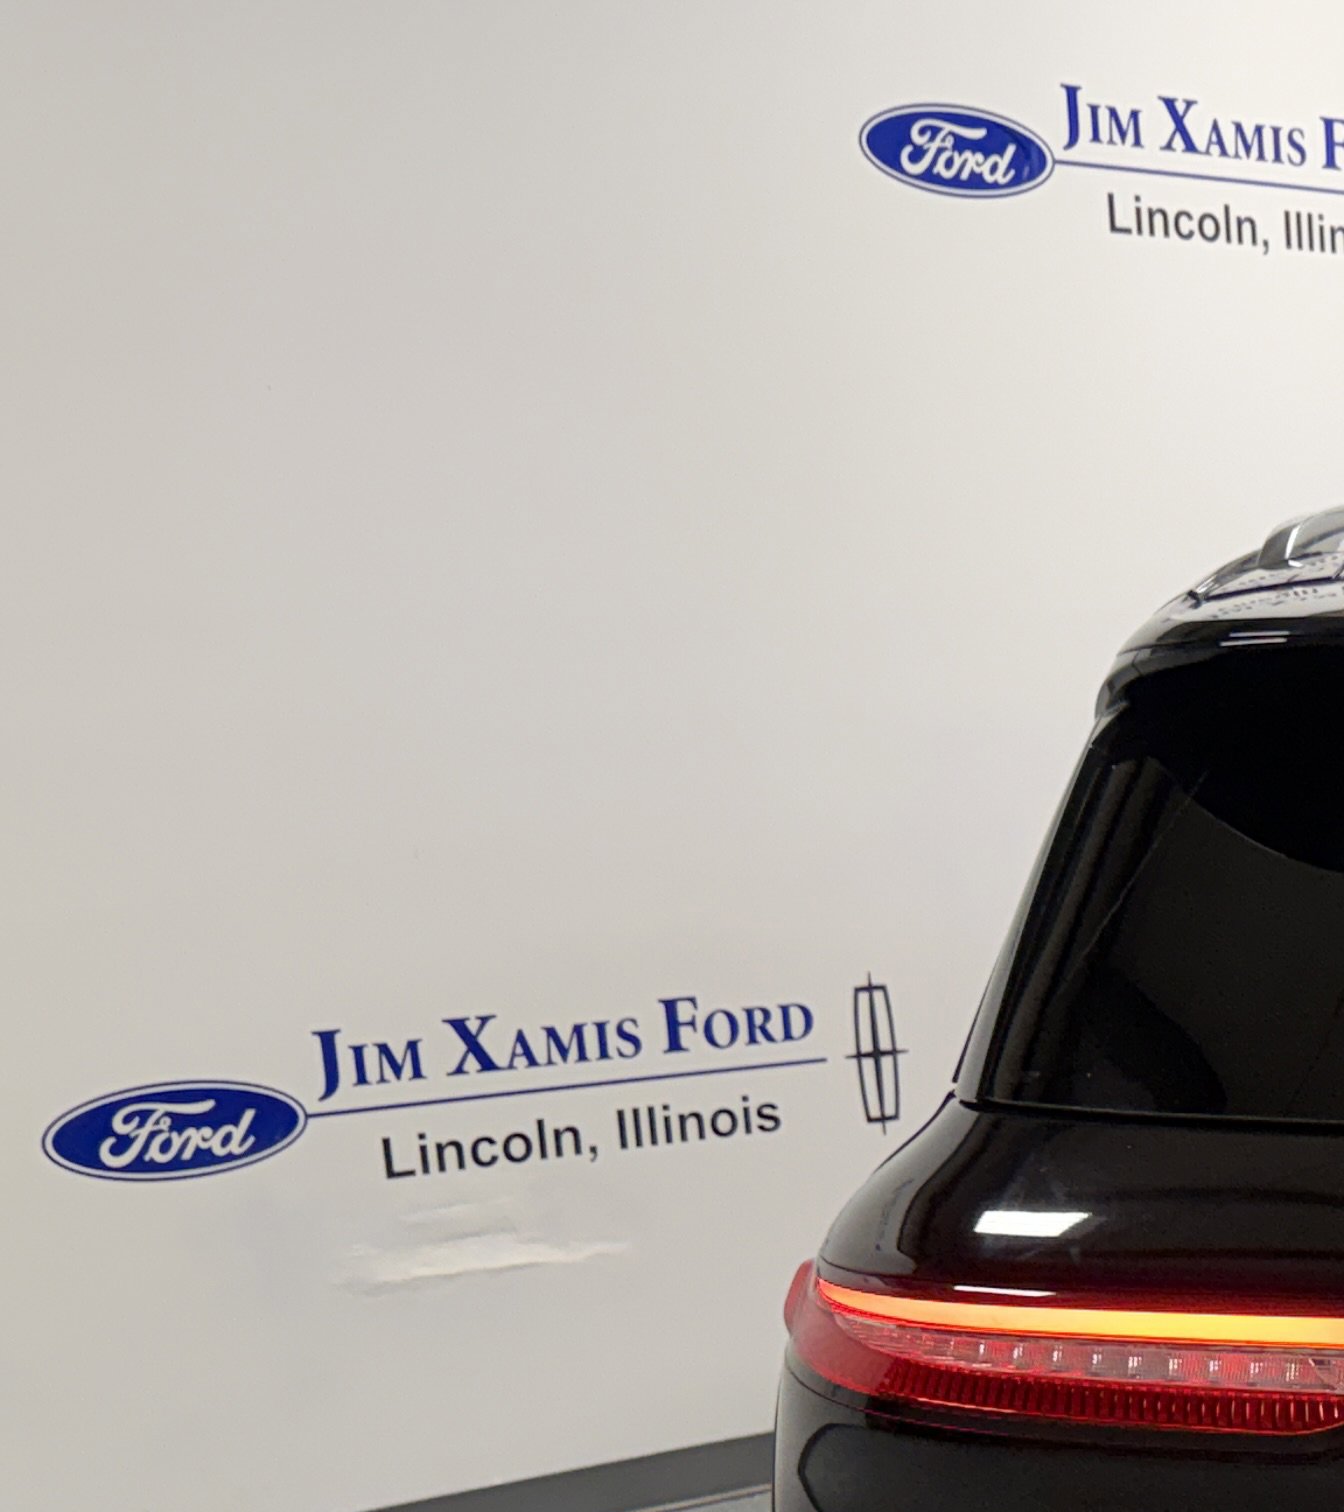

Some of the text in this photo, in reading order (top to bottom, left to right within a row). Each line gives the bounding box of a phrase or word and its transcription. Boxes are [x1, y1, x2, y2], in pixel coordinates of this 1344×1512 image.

[900, 117, 1017, 185] Ford
[1060, 83, 1145, 151] JIM
[1157, 95, 1307, 167] XAMIS
[1107, 192, 1270, 255] Lincoln,
[311, 996, 814, 1102] JIM XAMIS FORD
[99, 1099, 256, 1168] Ford
[381, 1095, 783, 1180] Lincoln, Illinois
